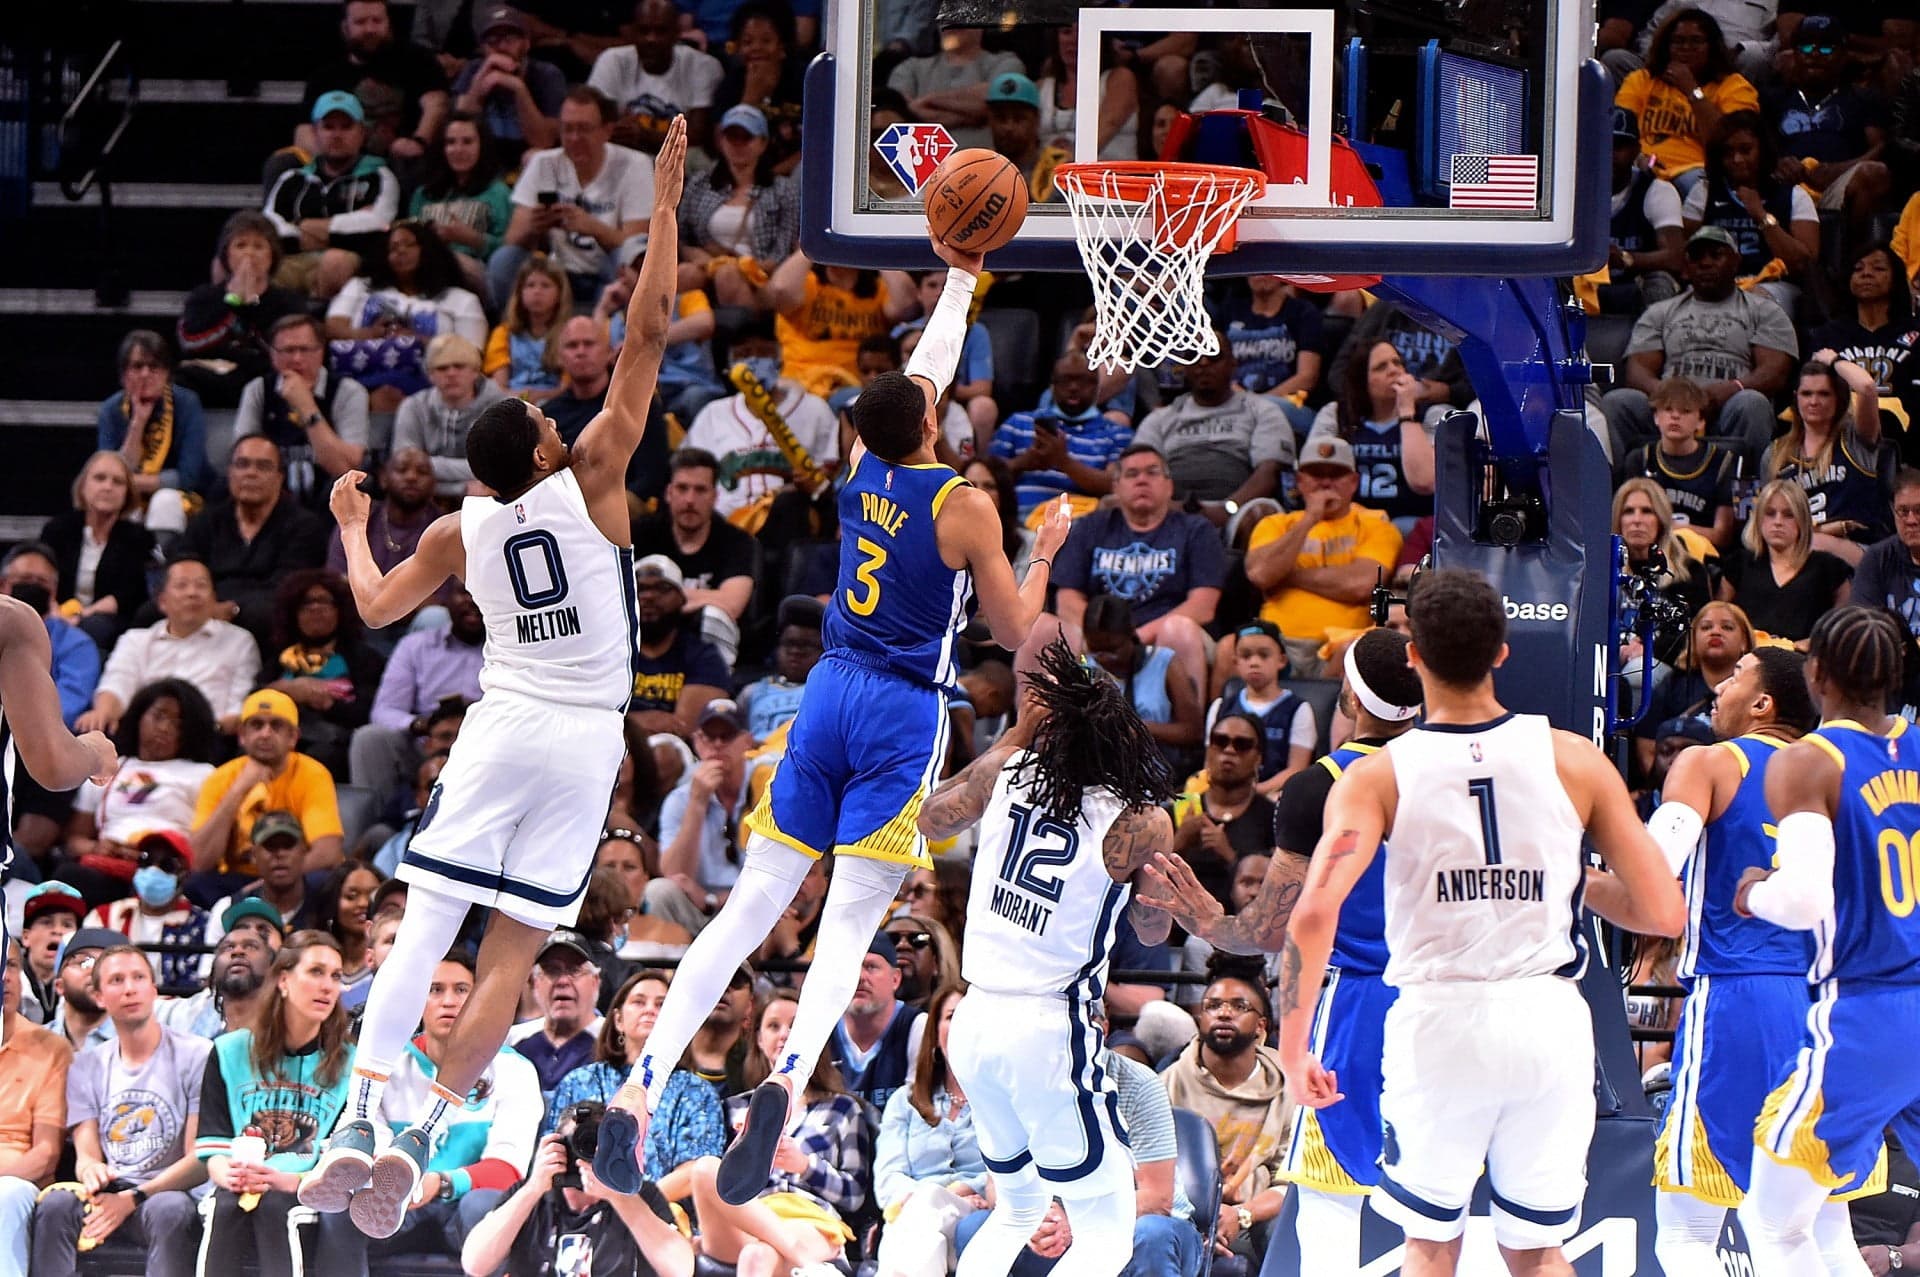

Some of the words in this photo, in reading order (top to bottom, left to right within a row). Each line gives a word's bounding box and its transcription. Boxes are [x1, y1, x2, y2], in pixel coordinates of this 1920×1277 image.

[922, 134, 939, 156] 75
[953, 192, 1008, 243] Wilson
[1357, 463, 1398, 498] 12
[861, 492, 909, 538] POOLE
[503, 529, 569, 610] 0
[846, 536, 887, 616] 3
[1098, 551, 1169, 576] MEMPHIS
[516, 606, 582, 644] MELTON
[1502, 596, 1569, 621] base
[1468, 777, 1502, 865] 1
[999, 802, 1080, 903] 12
[1437, 868, 1544, 902] ANDERSON
[990, 884, 1053, 936] MORANT
[107, 1136, 164, 1158] Memphis
